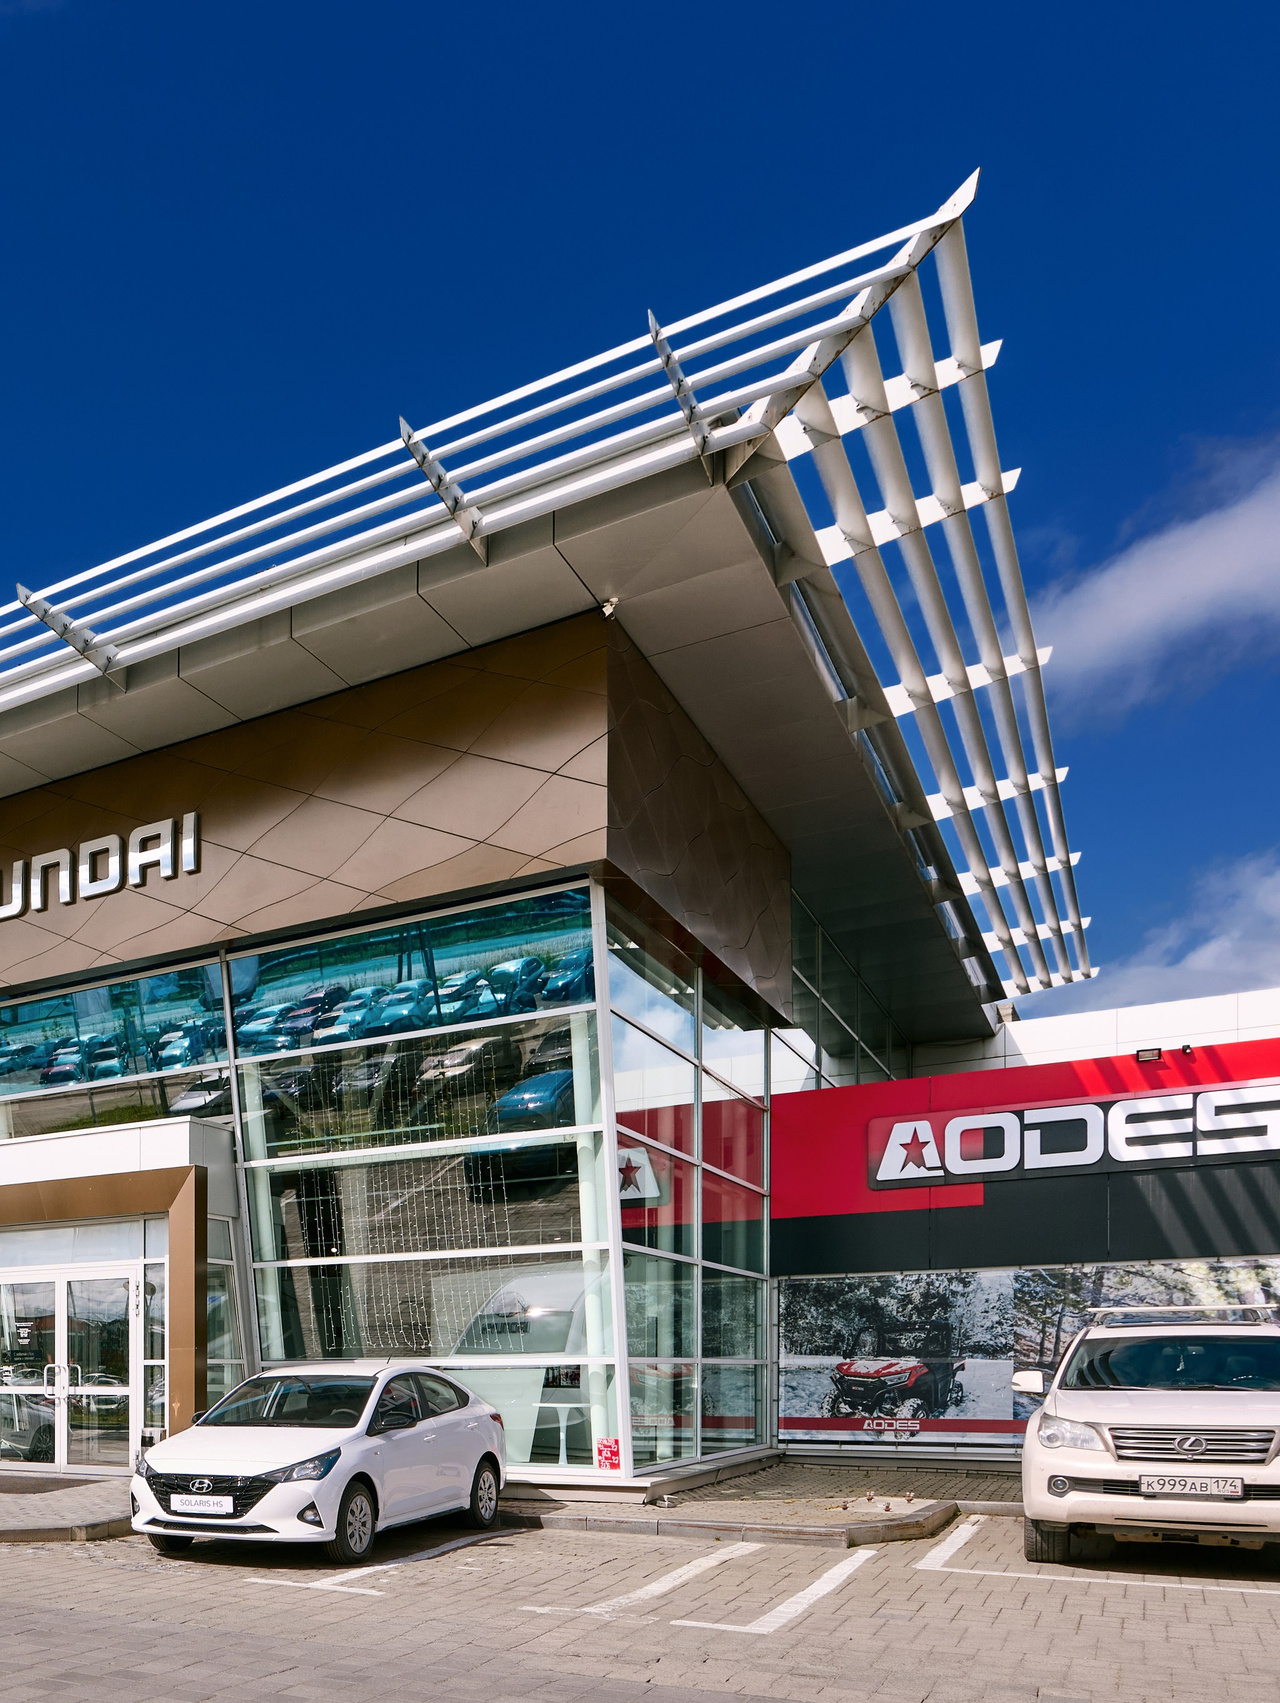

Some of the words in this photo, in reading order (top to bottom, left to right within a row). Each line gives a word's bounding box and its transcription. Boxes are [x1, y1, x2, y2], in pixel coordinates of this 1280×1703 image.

[876, 1085, 1280, 1182] AODES
[863, 1420, 920, 1430] AODES
[1146, 1478, 1209, 1492] К999АВ
[1213, 1479, 1237, 1490] 174
[180, 1499, 211, 1508] SOLARIS
[212, 1500, 224, 1508] HS
